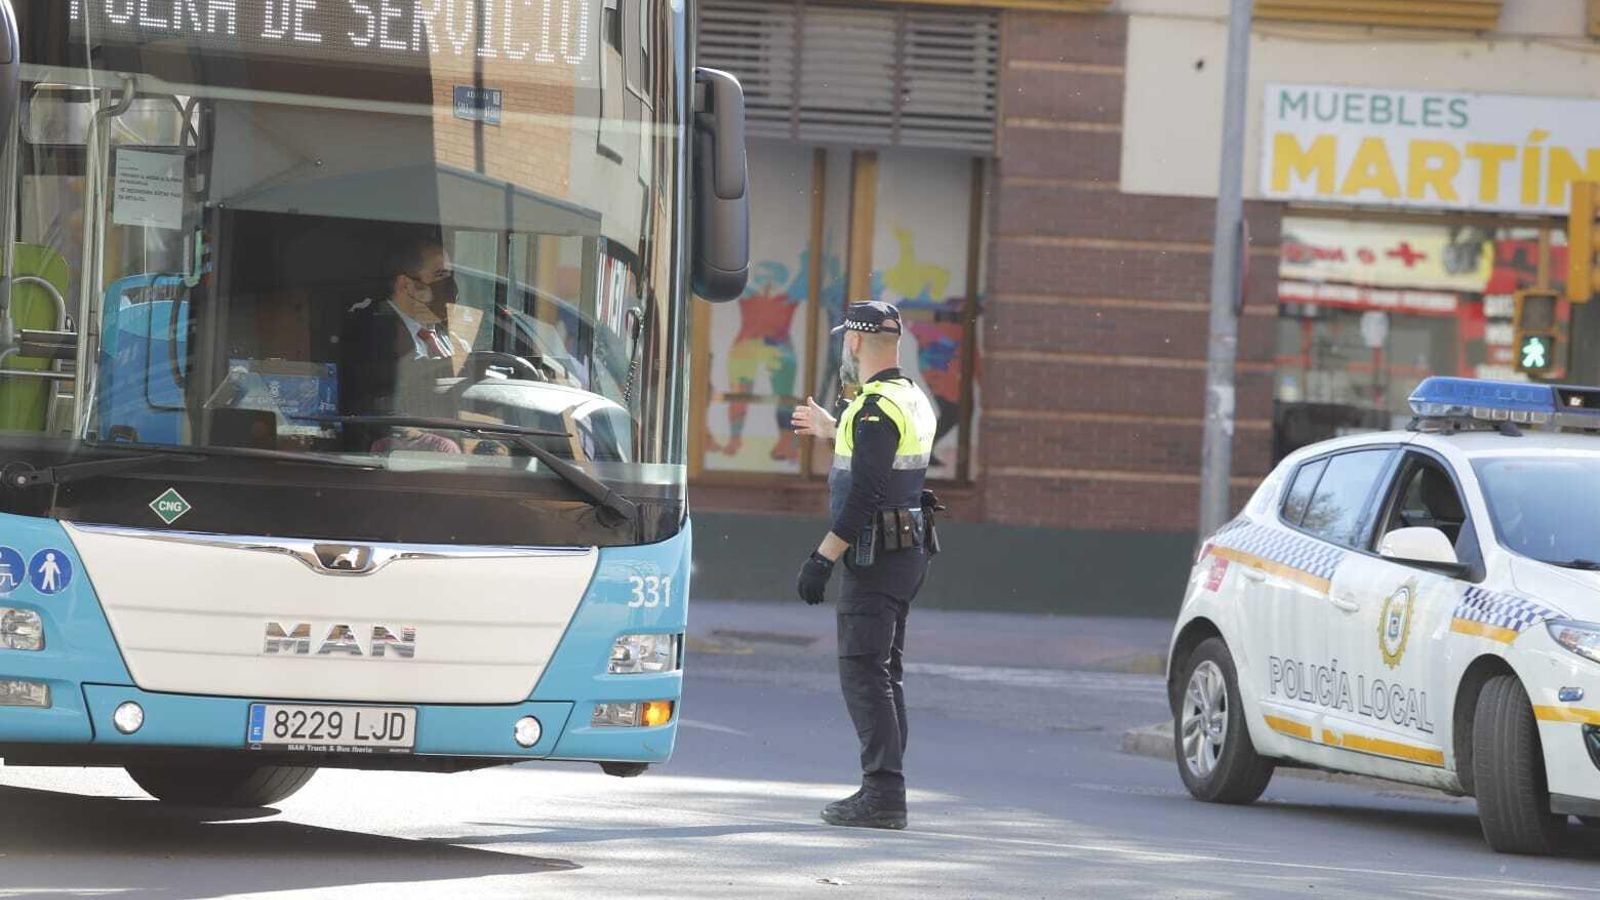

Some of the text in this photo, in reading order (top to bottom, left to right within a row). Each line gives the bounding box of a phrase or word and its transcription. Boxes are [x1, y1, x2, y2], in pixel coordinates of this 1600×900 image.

[1278, 90, 1471, 130] MUEBLES
[1269, 128, 1600, 207] MARTÍN
[158, 500, 183, 512] CNG
[627, 575, 671, 608] 331
[264, 622, 416, 658] MAN
[1269, 655, 1434, 734] POLICÍA LOCAL
[273, 710, 406, 742] 8229 LJD
